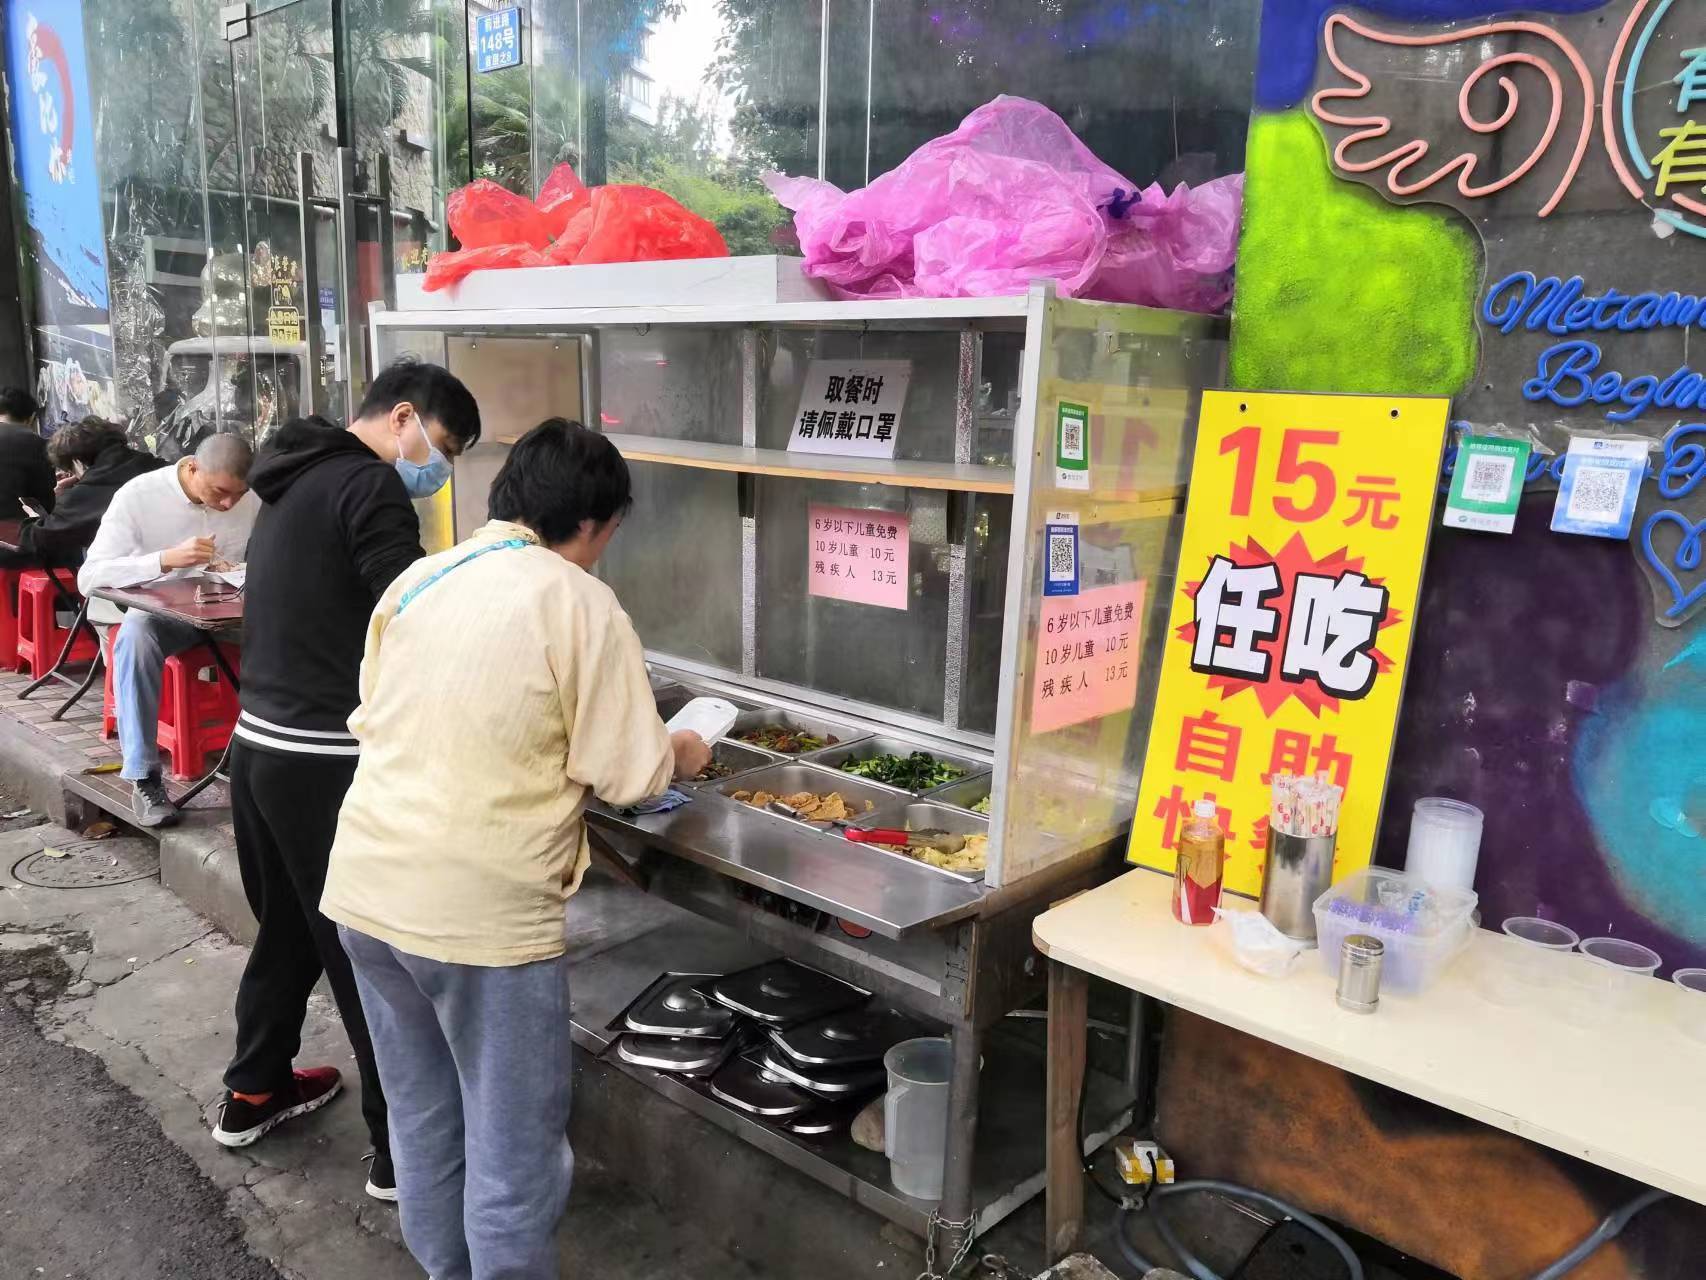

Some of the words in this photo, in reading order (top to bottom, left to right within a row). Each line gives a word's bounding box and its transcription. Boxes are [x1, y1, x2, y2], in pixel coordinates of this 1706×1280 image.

[480, 27, 515, 54] 148号
[824, 375, 884, 405] 取餐时
[798, 410, 896, 443] 请佩戴口罩
[1218, 426, 1401, 530] 15元
[815, 517, 898, 540] 6岁以下儿童免费
[815, 540, 859, 557] 10岁儿童
[870, 547, 895, 562] 10元
[815, 560, 856, 579] 残疾人
[872, 569, 897, 584] 13元
[1047, 601, 1134, 634] 6岁以下儿童免费
[1191, 554, 1390, 701] 任吃
[1044, 639, 1095, 666] 10岁儿童
[1105, 632, 1129, 652] 10元
[1041, 670, 1089, 700] 残疾人
[1105, 661, 1128, 682] 13元
[1174, 710, 1353, 803] 自助
